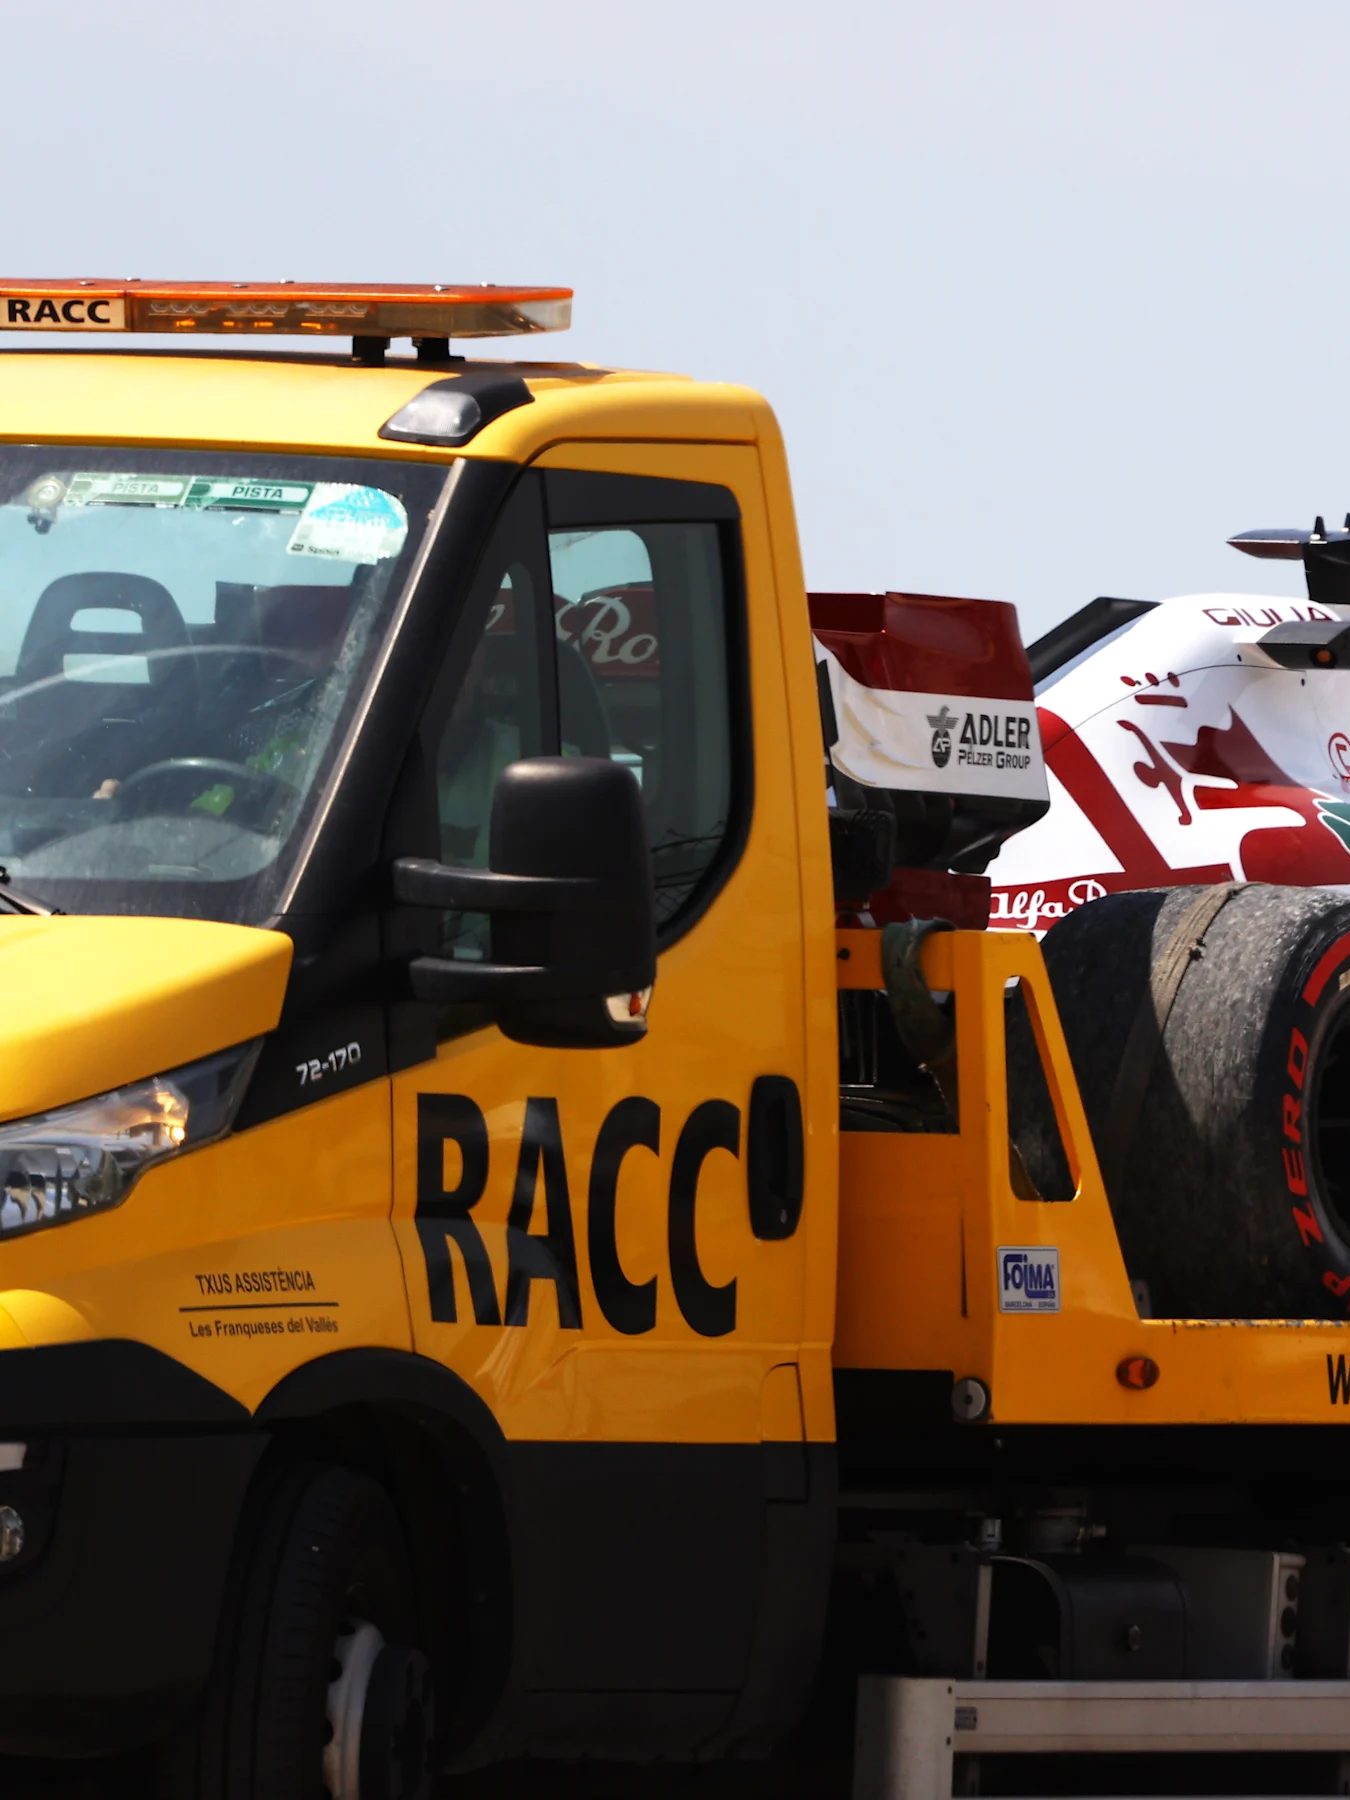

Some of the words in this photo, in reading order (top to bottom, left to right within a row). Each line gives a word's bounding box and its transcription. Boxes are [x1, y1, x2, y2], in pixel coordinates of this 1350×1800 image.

[7, 298, 111, 323] RACC
[111, 482, 160, 495] PISTA
[231, 486, 284, 499] PISTA
[959, 712, 1031, 750] ADLER
[958, 749, 993, 767] PELZER
[995, 751, 1031, 770] GROUP
[295, 1041, 362, 1086] 72-170
[1281, 1027, 1325, 1247] ZERO
[414, 1091, 742, 1338] RACC
[194, 1272, 233, 1296] TXUS
[188, 1320, 213, 1338] Les
[214, 1320, 285, 1340] Franqueses
[286, 1316, 304, 1334] del
